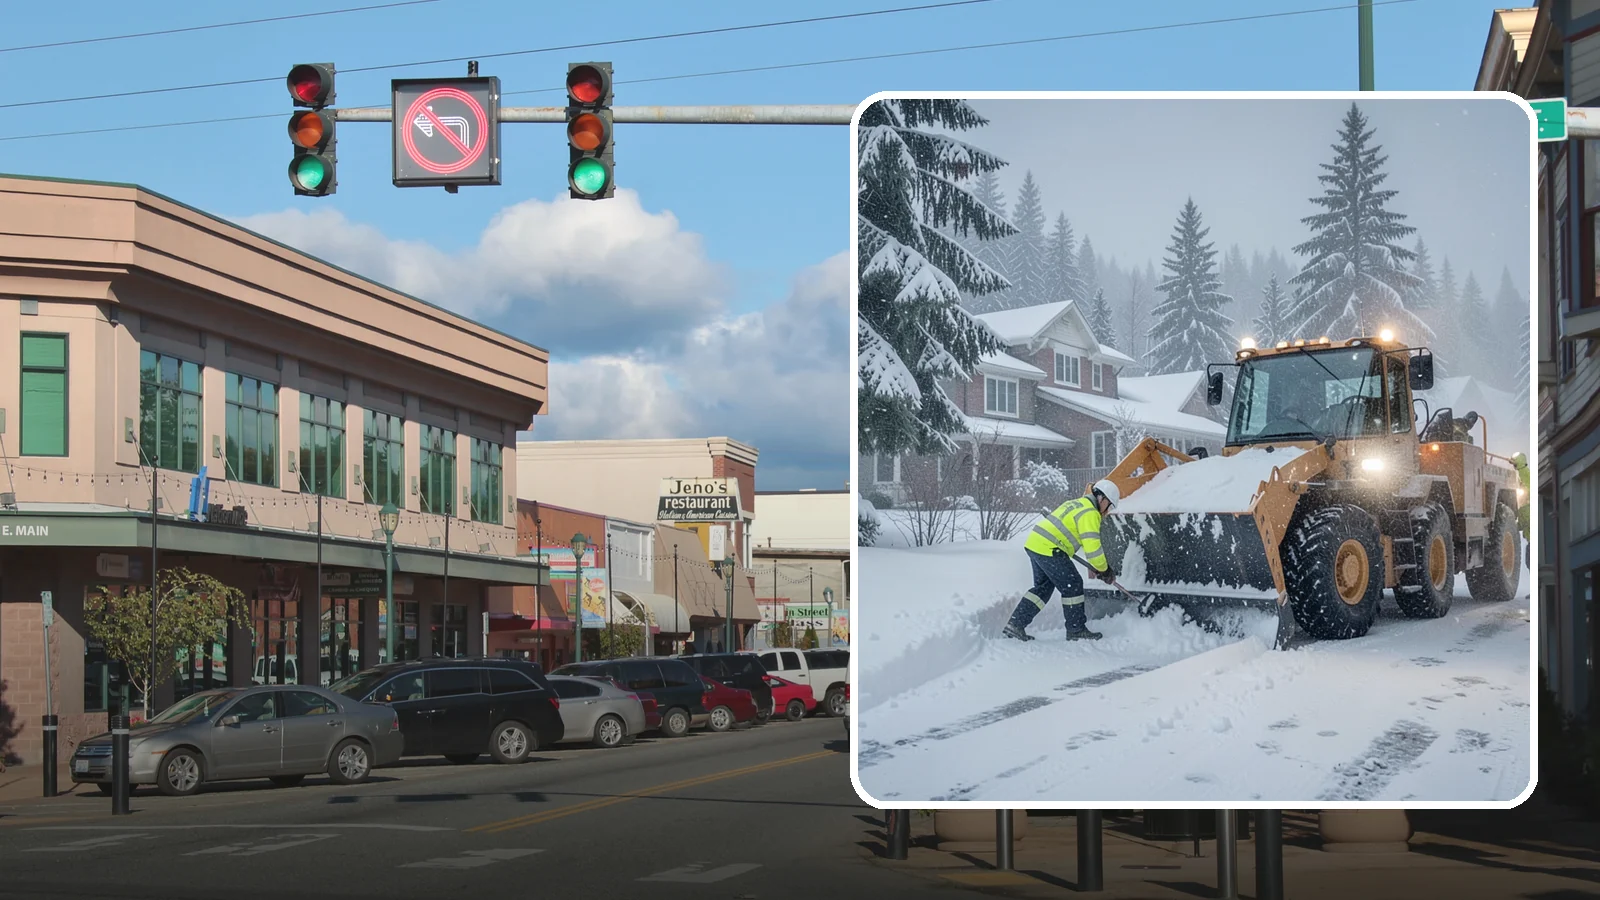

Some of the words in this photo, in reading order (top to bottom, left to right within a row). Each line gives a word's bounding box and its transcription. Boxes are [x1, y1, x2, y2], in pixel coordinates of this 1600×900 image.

[670, 479, 728, 495] Jeno's
[665, 496, 731, 509] restaurant
[685, 509, 714, 520] American
[715, 509, 738, 520] Cuisine
[2, 525, 13, 536] E.
[15, 525, 49, 536] MAIN
[797, 607, 829, 617] Street
[791, 619, 824, 627] lass
